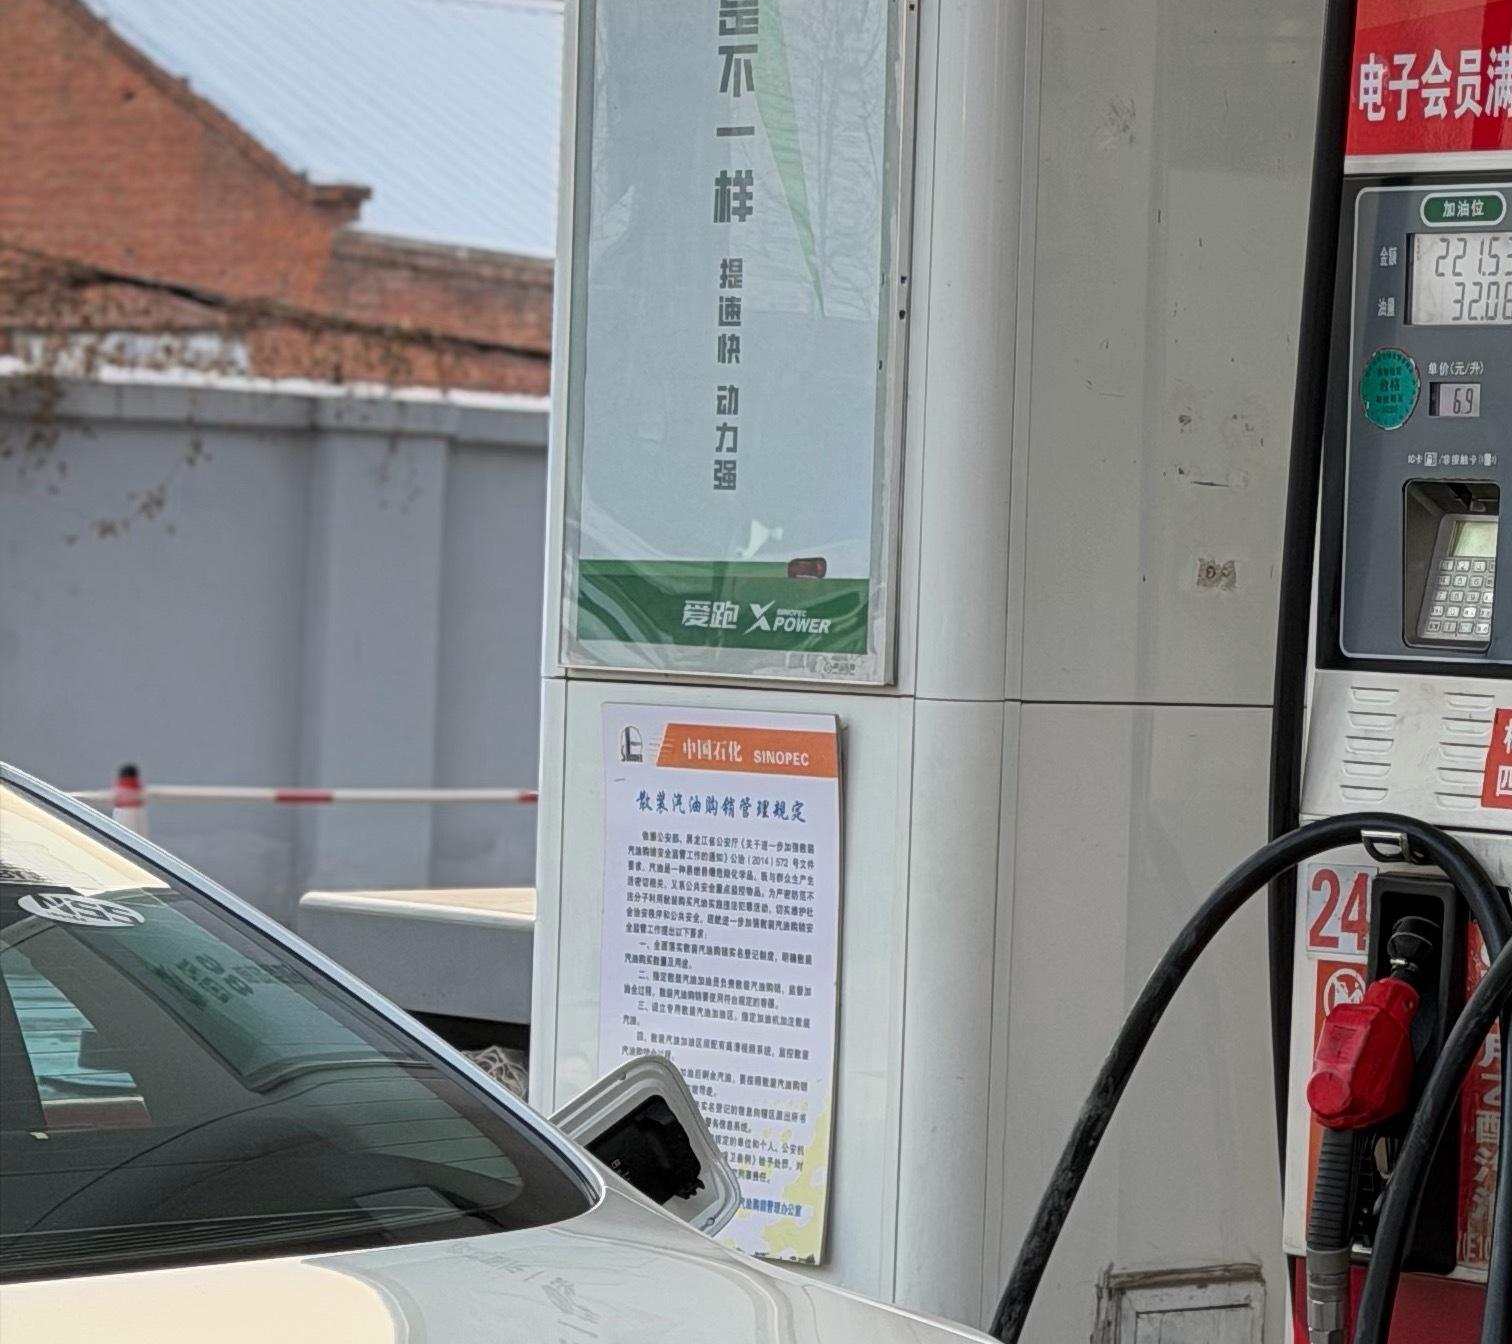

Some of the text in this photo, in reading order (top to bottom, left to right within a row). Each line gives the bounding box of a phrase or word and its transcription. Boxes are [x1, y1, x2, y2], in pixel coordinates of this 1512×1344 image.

[1442, 200, 1485, 217] 加油位
[682, 600, 740, 629] 爱跑
[683, 736, 809, 767] 中国石化 SINOPEC
[636, 789, 807, 824] 散装汽油购销管理规定
[1307, 868, 1370, 951] 24
